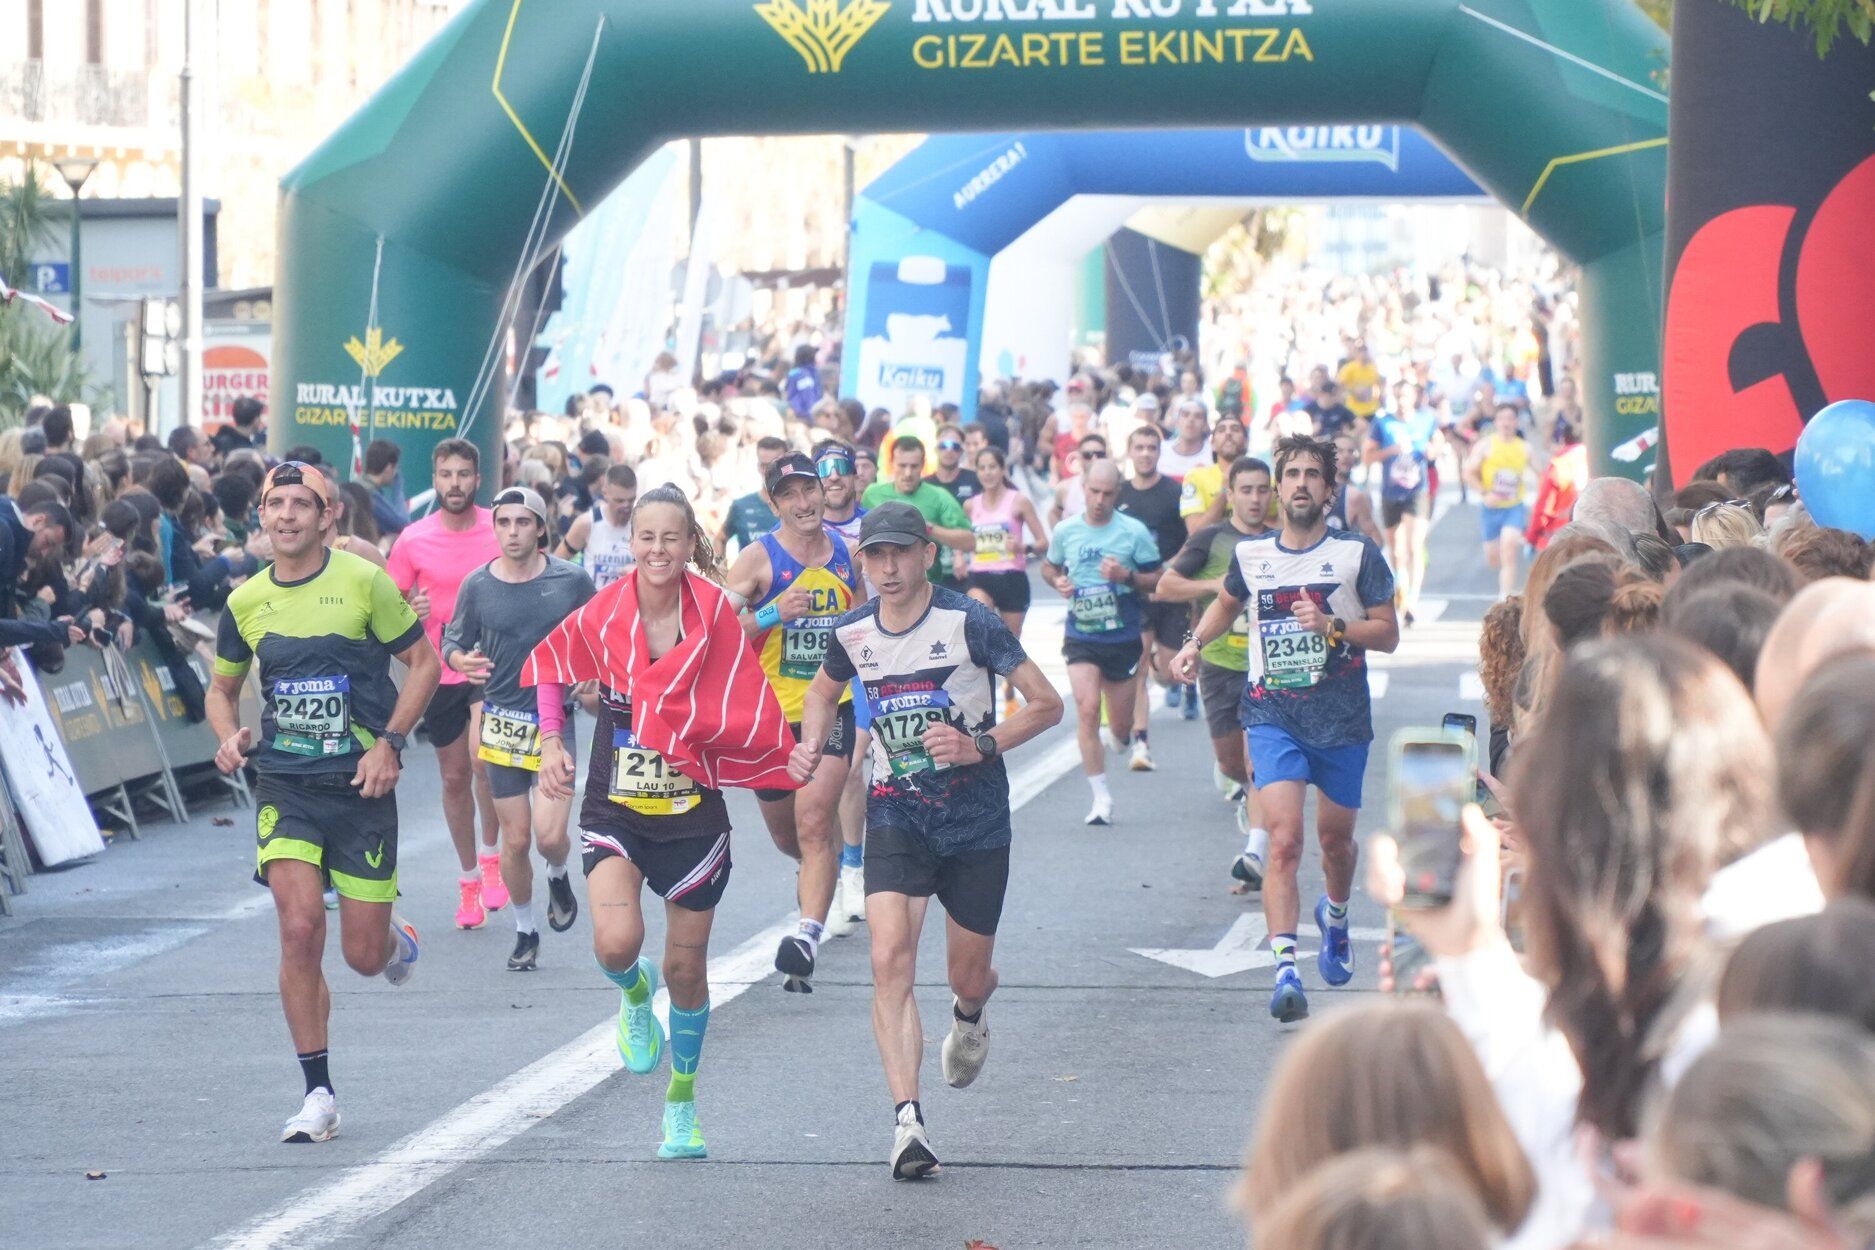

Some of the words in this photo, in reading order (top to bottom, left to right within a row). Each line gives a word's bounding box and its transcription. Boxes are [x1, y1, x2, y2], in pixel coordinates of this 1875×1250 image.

[912, 32, 1104, 68] GIZARTE
[1119, 28, 1313, 65] EKINTZA
[881, 363, 943, 389] Kaiku
[297, 383, 367, 405] RURAL
[372, 386, 457, 409] KUTXA
[296, 407, 369, 427] GIZARE
[375, 411, 456, 430] EKINTZA
[1076, 595, 1114, 611] 2044
[1267, 635, 1324, 658] 2348
[1272, 657, 1324, 668] ESTANISLAO
[868, 687, 879, 700] 58
[278, 696, 341, 719] 2420
[289, 722, 331, 731] RICARDO
[490, 717, 527, 741] 354
[636, 782, 658, 790] LAU
[662, 782, 675, 790] 10
